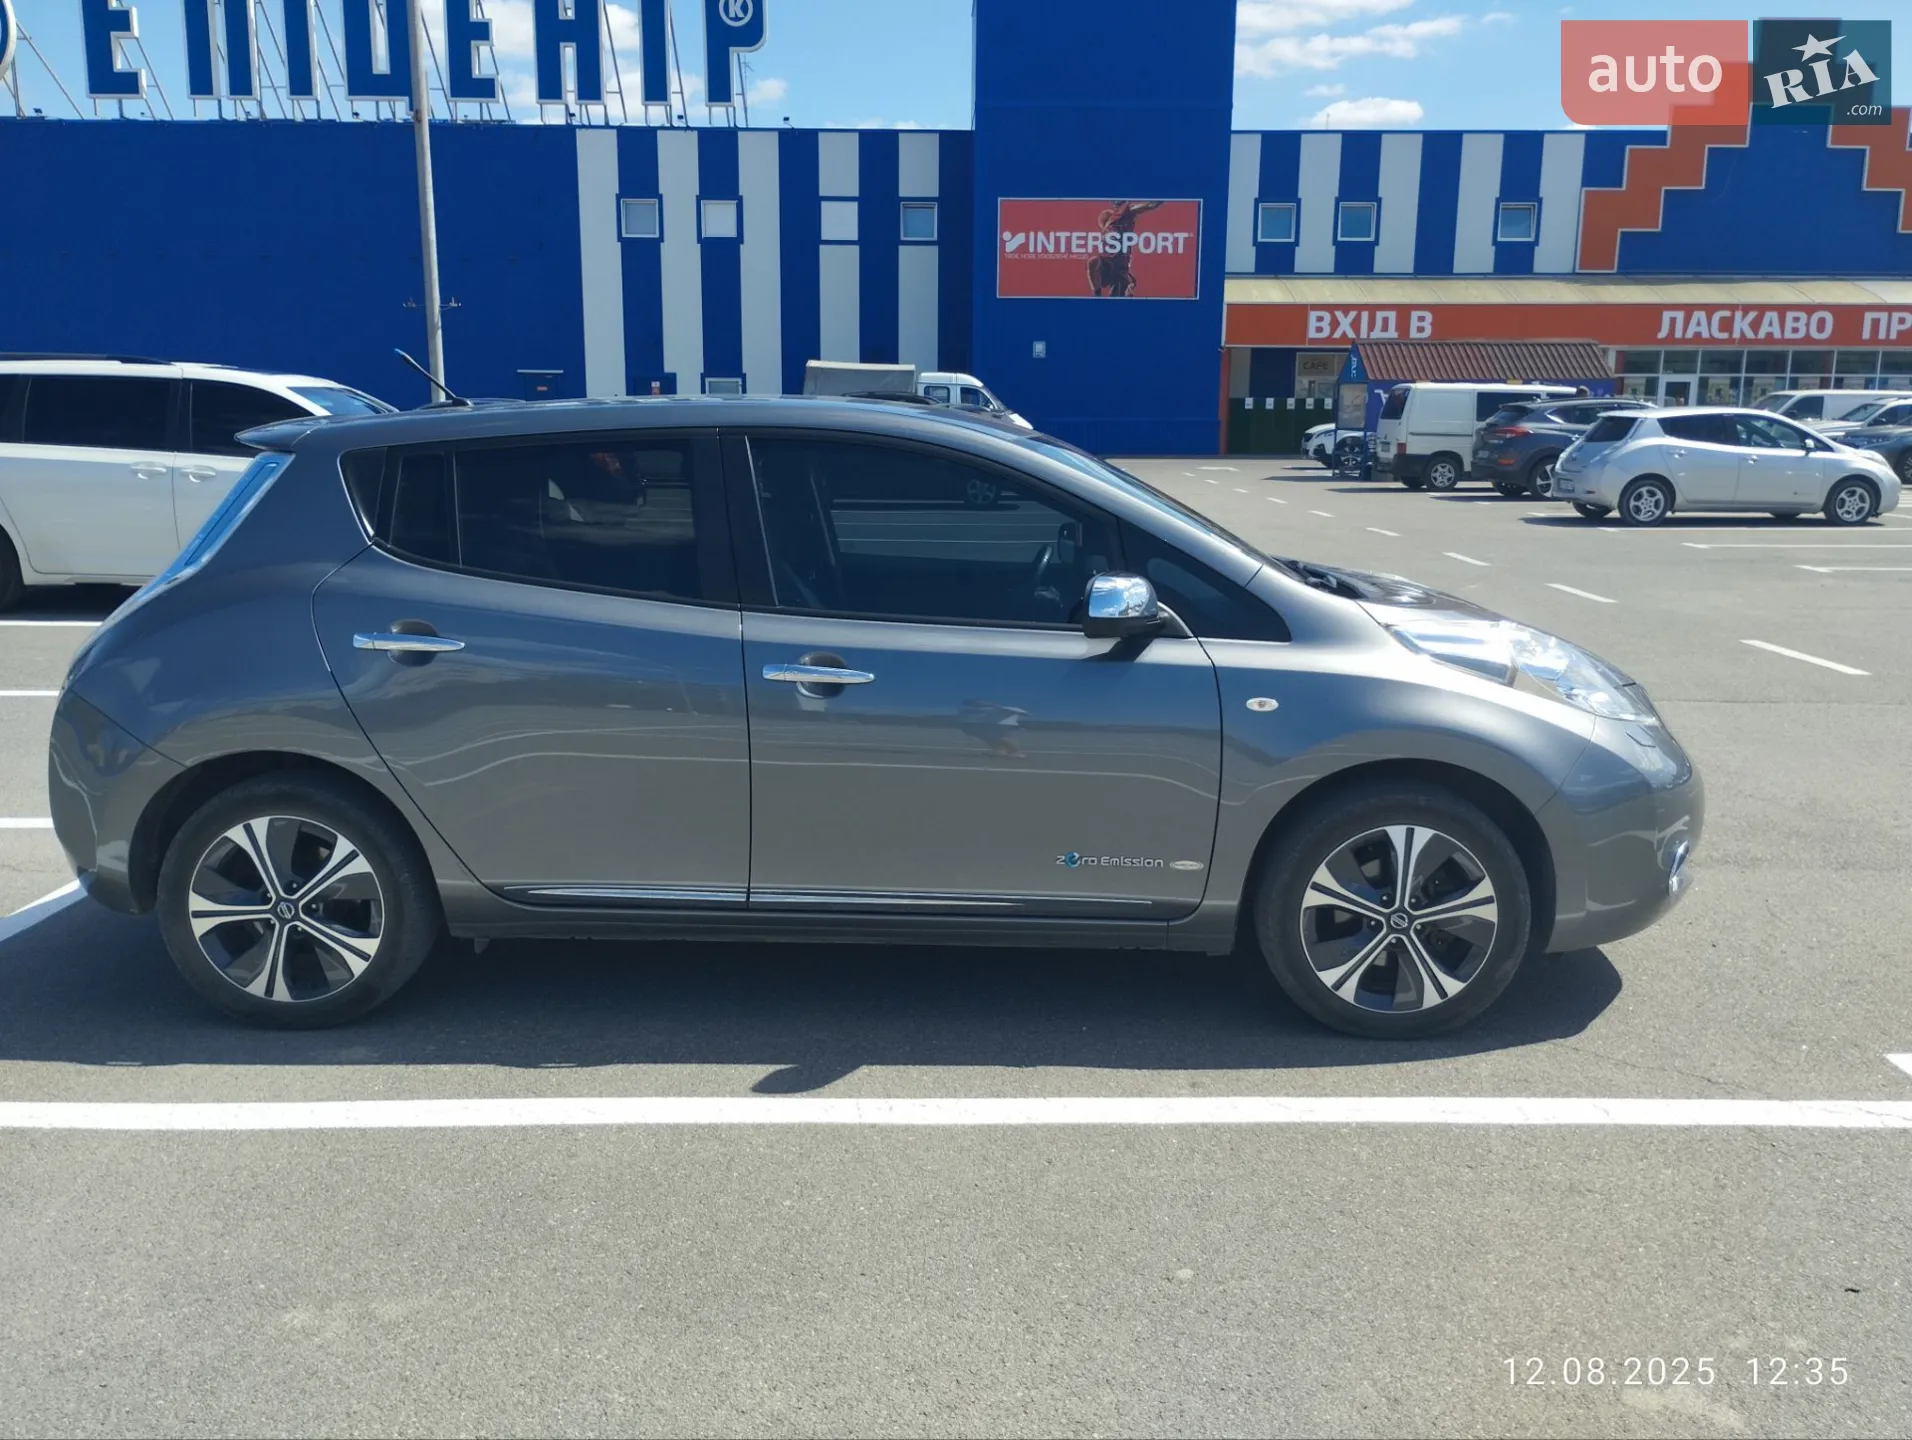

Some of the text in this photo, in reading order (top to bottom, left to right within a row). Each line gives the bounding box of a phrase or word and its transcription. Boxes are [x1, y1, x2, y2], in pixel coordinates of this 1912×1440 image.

[1028, 231, 1190, 254] INTERSPORT
[1308, 310, 1433, 340] ВХІД В
[1657, 309, 1834, 340] ЛАСКАВО
[1100, 856, 1164, 868] Emission
